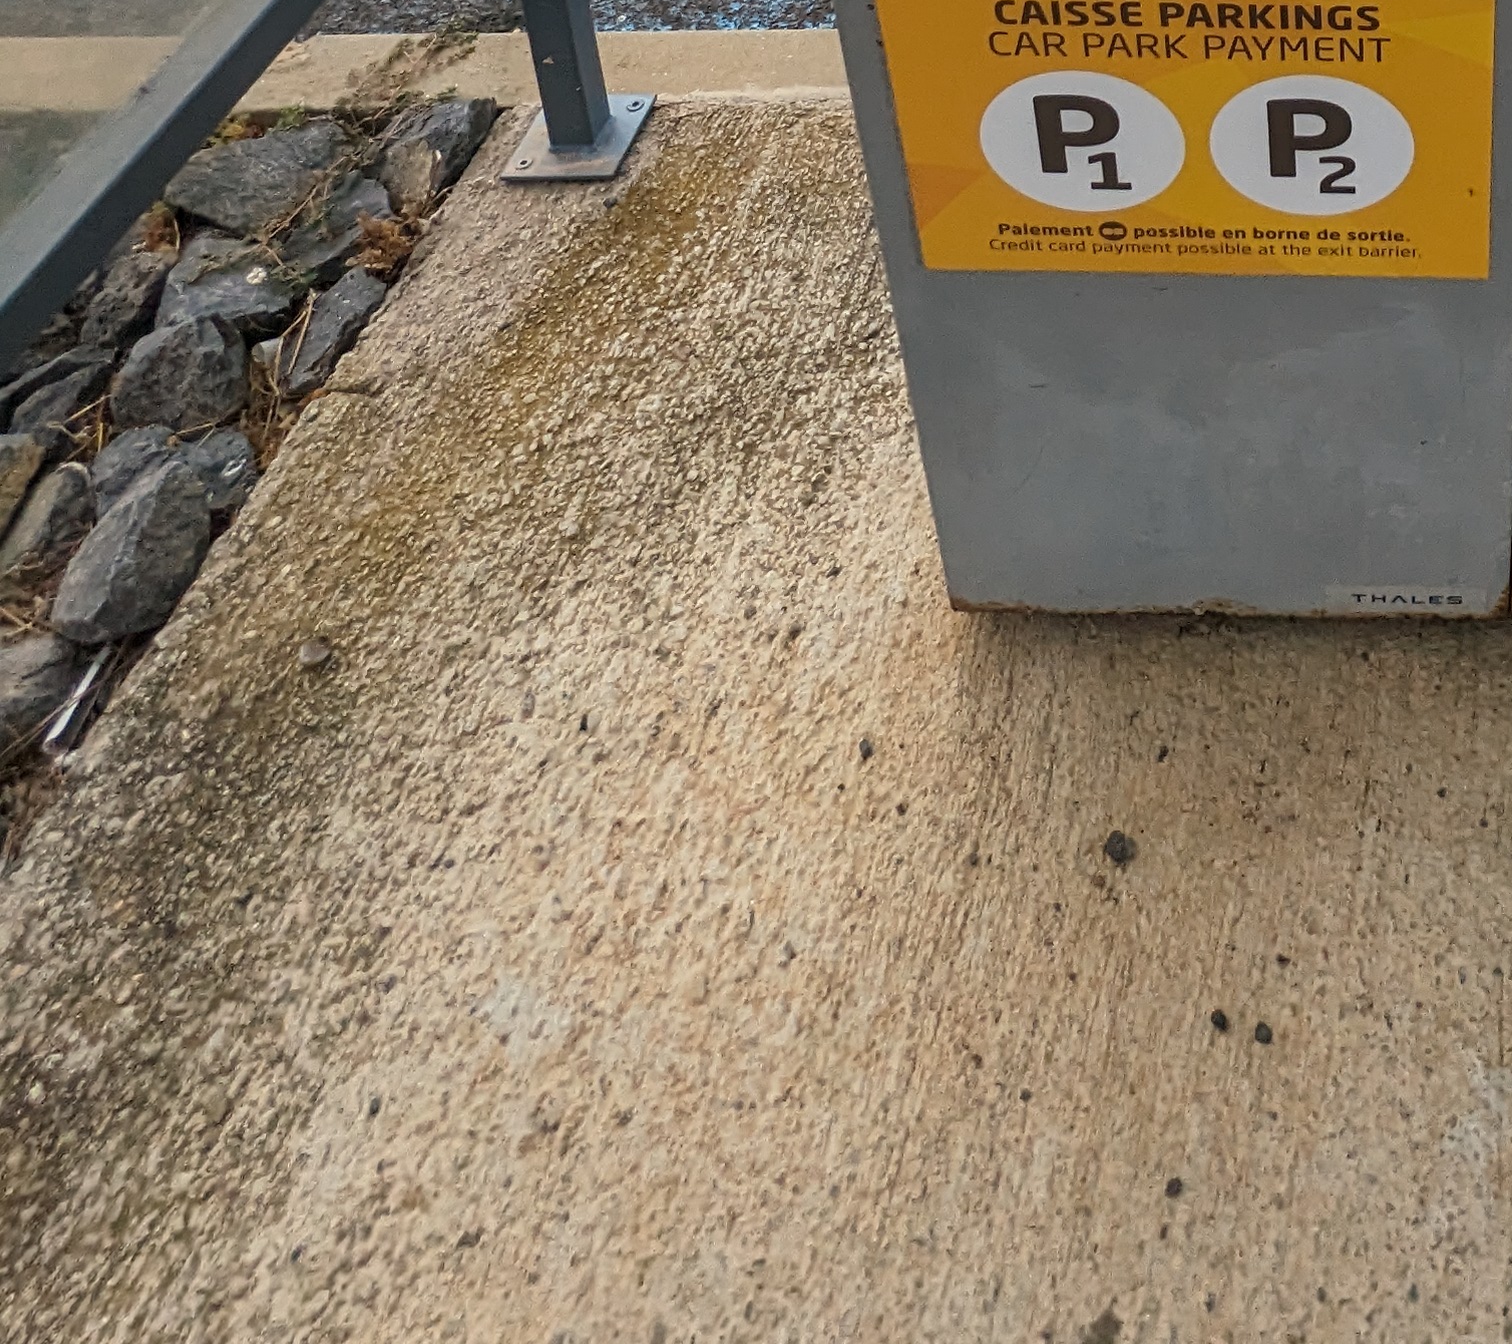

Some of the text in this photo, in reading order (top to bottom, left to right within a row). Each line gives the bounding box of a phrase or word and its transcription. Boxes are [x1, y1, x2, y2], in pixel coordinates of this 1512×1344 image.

[994, 0, 1381, 31] CAISSE PARKINGS
[988, 30, 1392, 63] CAR PARK PAYMENT
[998, 222, 1094, 238] Paiement
[1133, 225, 1216, 243] possible
[1222, 230, 1247, 240] en
[1252, 226, 1310, 241] borne
[1316, 227, 1341, 241] de
[989, 238, 1421, 259] Credit card payment possible at the exit barrier.
[1351, 593, 1463, 605] THALES
